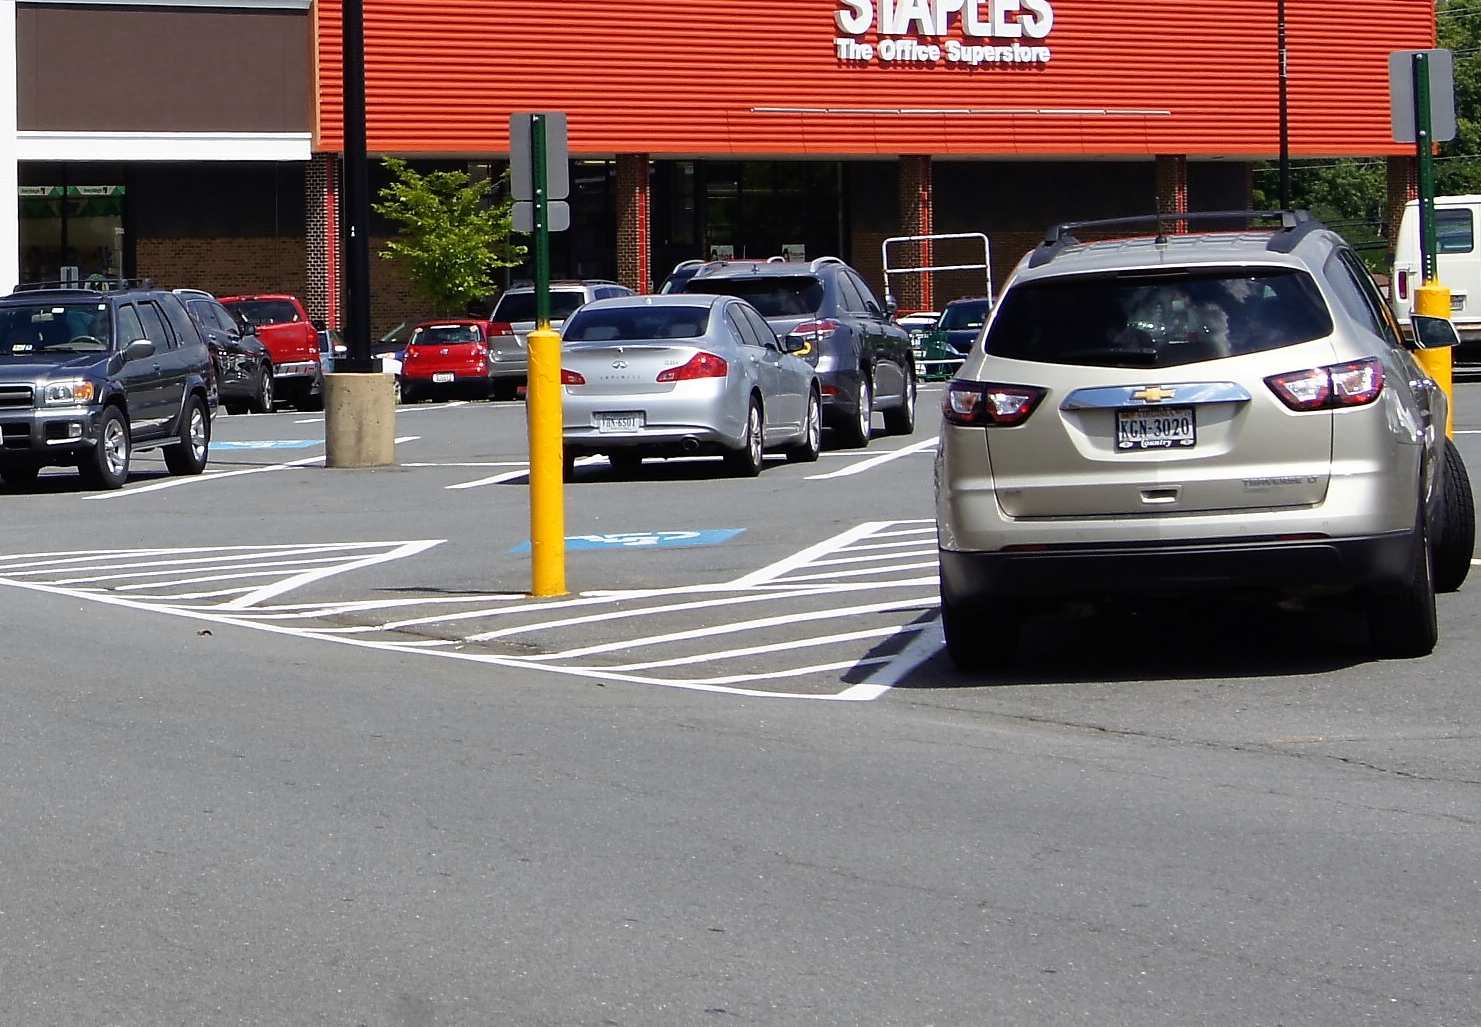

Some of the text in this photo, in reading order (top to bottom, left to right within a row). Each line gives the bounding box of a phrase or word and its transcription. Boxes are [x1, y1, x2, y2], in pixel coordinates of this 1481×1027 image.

[834, 38, 1050, 66] The Office Superstore
[1141, 439, 1172, 448] Country
